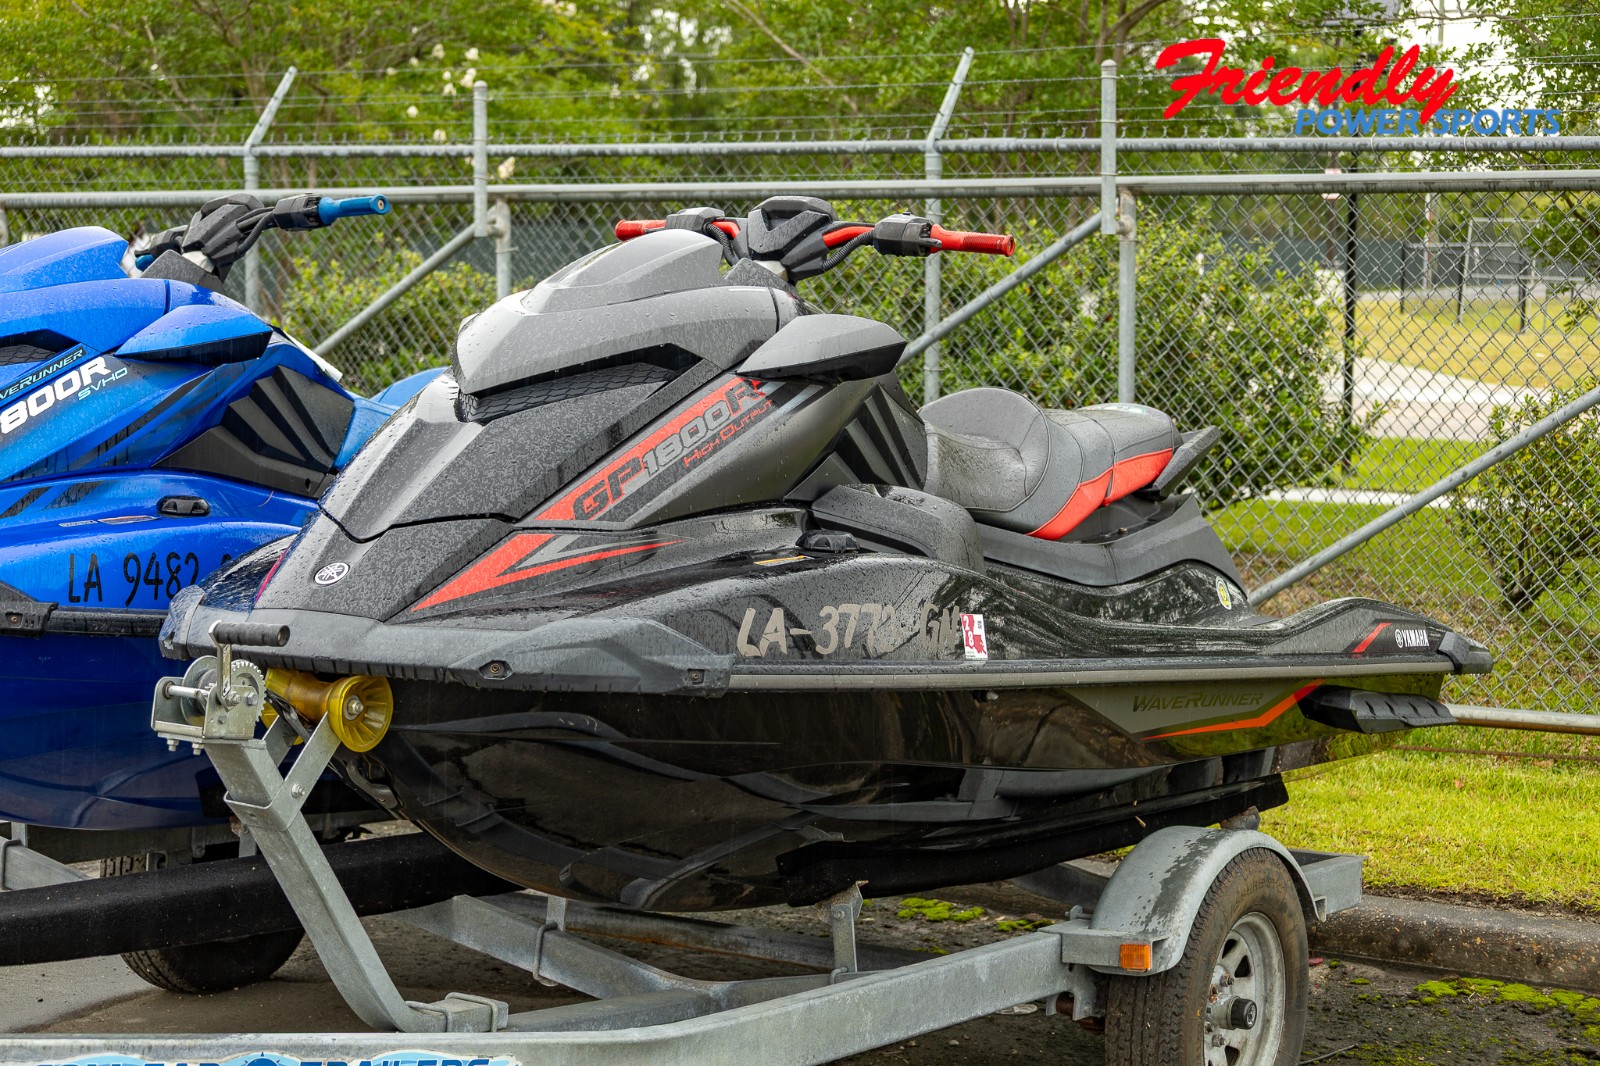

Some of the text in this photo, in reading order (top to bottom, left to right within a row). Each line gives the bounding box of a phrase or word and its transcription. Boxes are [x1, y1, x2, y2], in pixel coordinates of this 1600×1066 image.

[78, 367, 128, 401] SVHO
[69, 551, 200, 607] LA 9482
[1401, 629, 1430, 647] YAMAHA
[1132, 692, 1265, 712] WAVERUNNER
